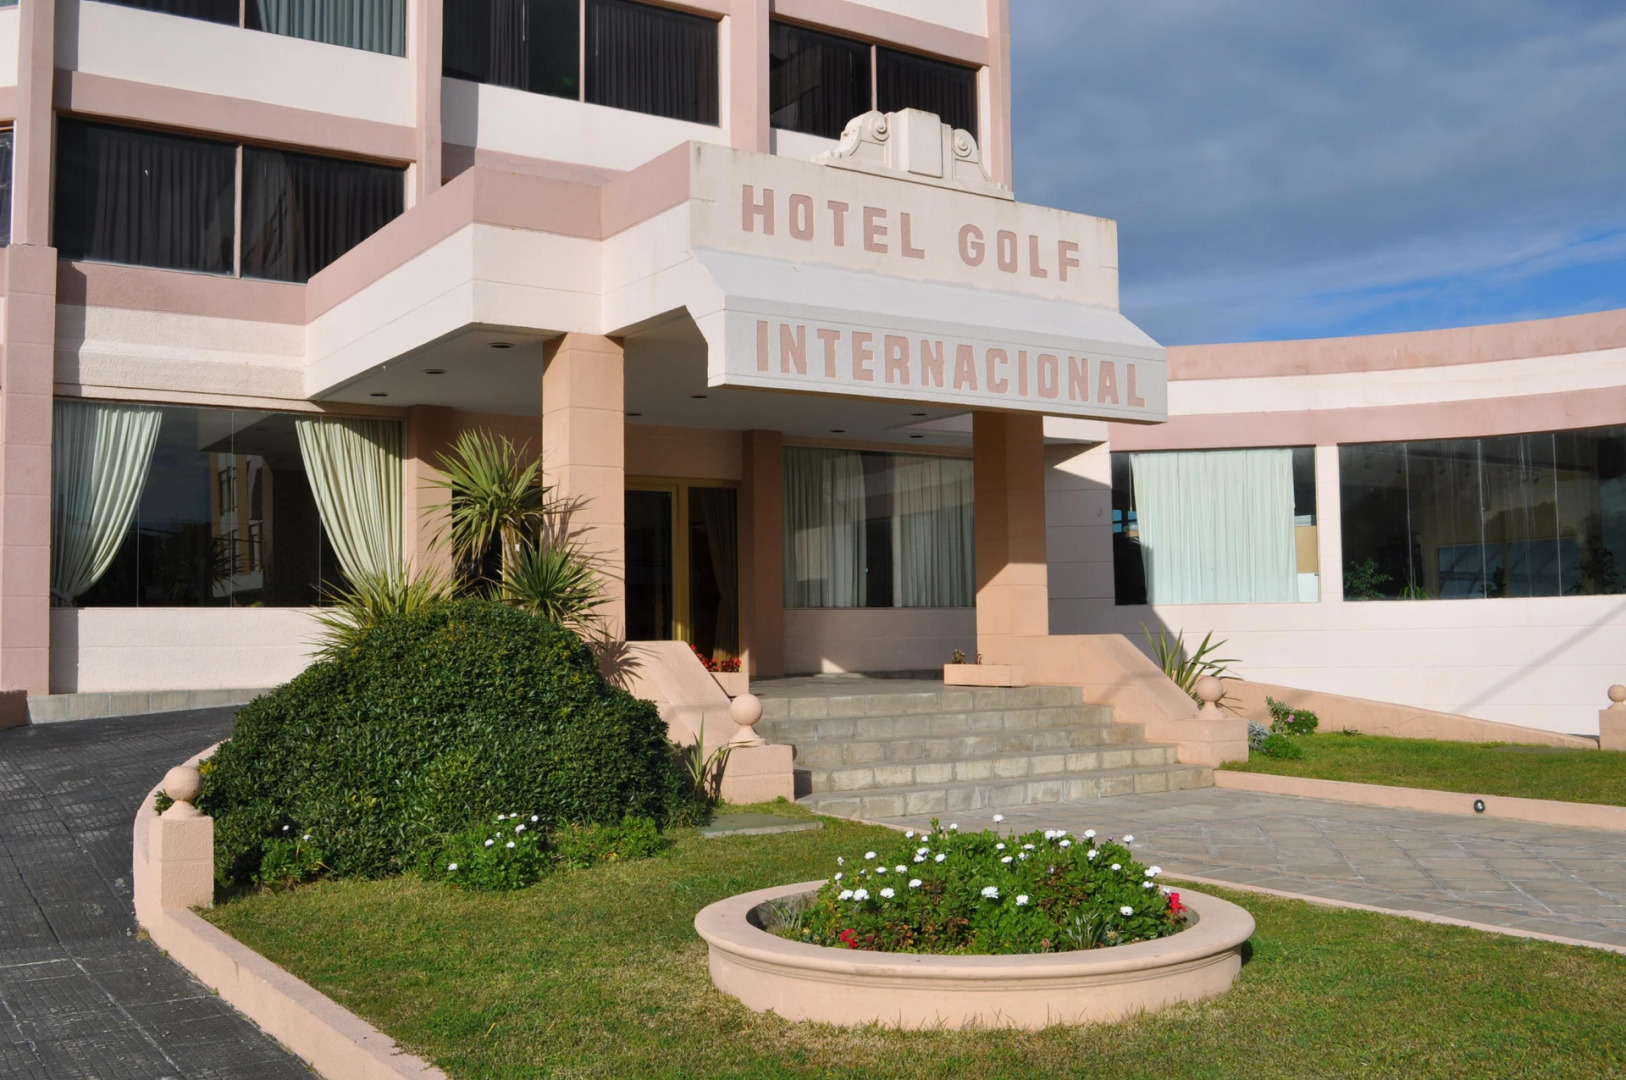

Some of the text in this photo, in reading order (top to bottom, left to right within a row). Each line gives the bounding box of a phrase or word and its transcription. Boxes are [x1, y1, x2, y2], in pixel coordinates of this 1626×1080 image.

[742, 184, 1080, 282] HOTEL GOLF
[756, 320, 1146, 407] INTERNACIONAL
